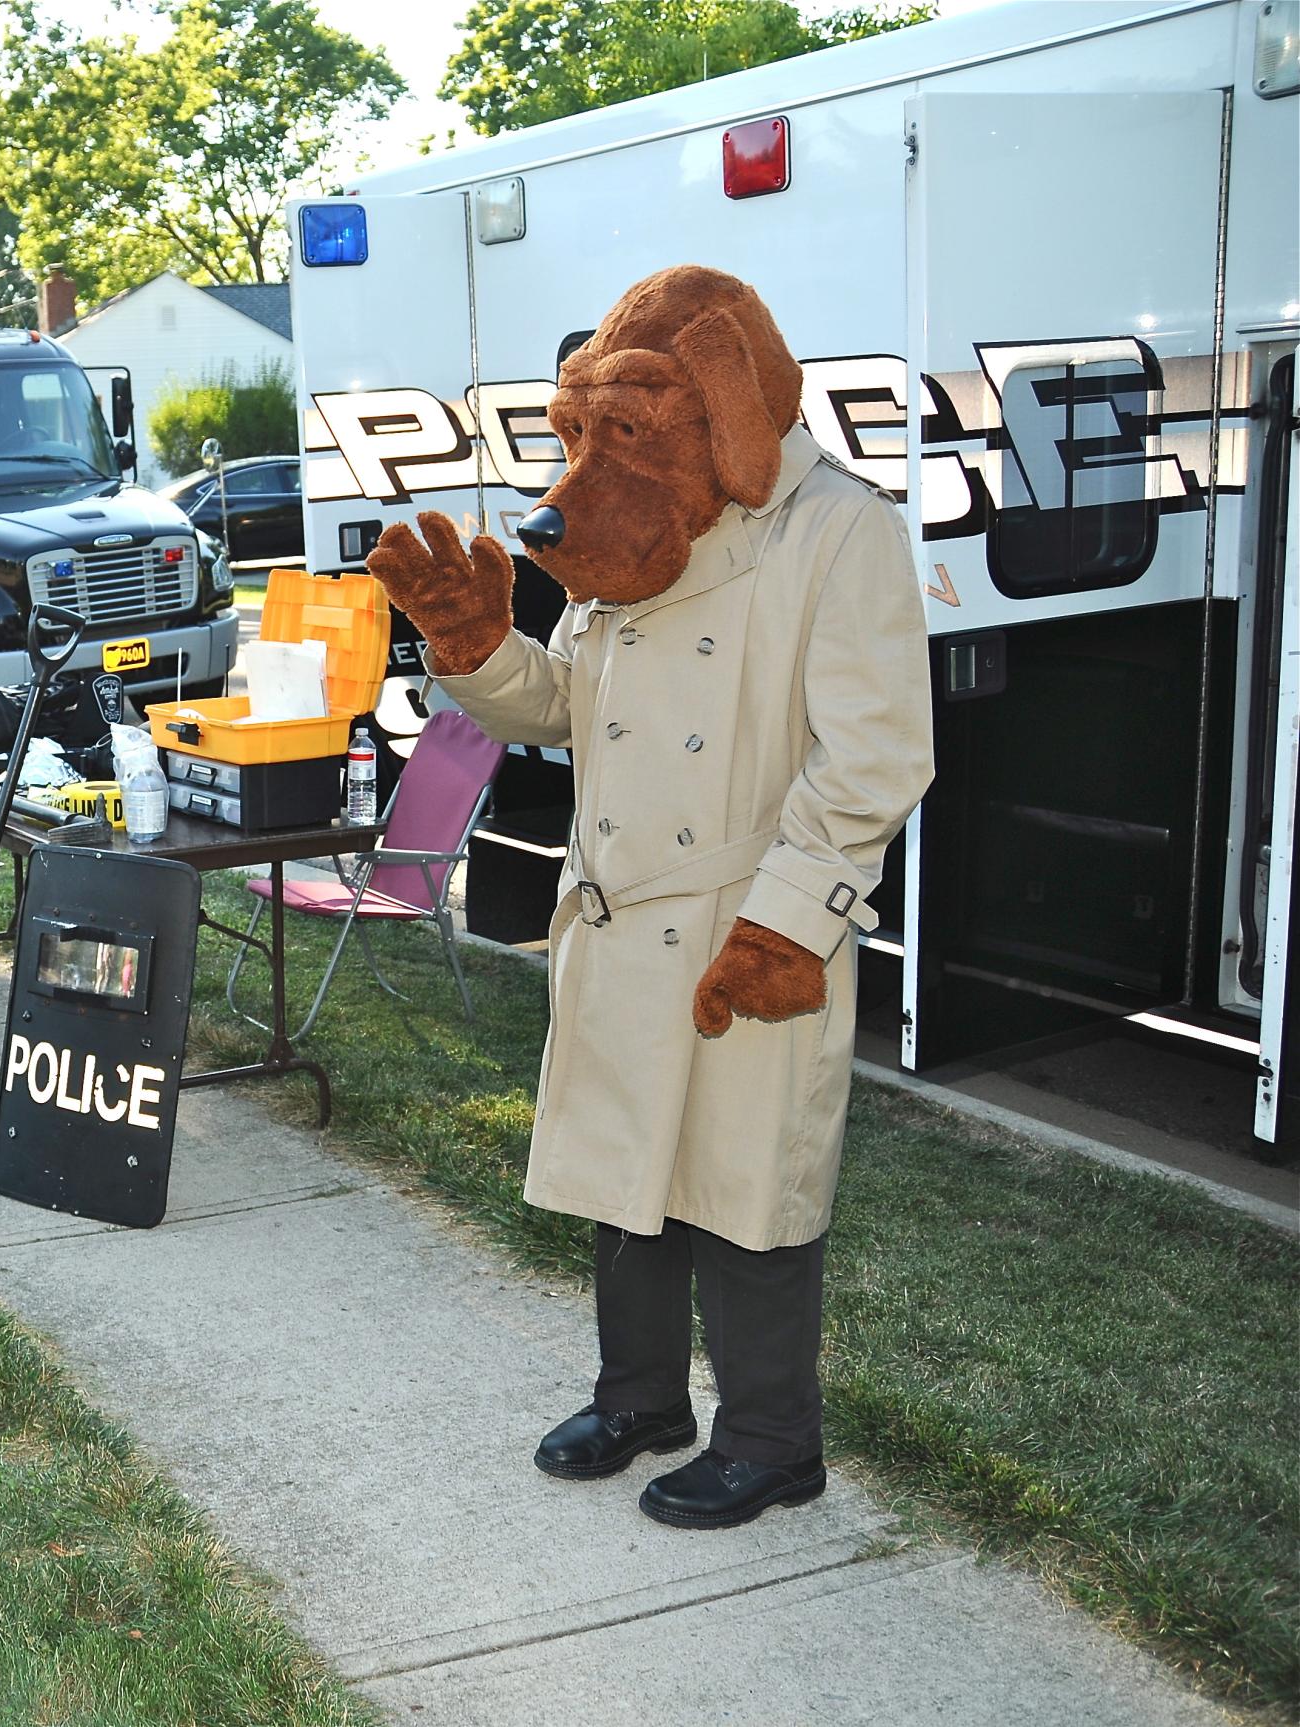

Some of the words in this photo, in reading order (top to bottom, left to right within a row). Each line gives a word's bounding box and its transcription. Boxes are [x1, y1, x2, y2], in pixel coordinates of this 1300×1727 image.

[311, 337, 1190, 541] POCE
[73, 799, 108, 819] LIN
[5, 1033, 165, 1129] POLICE
